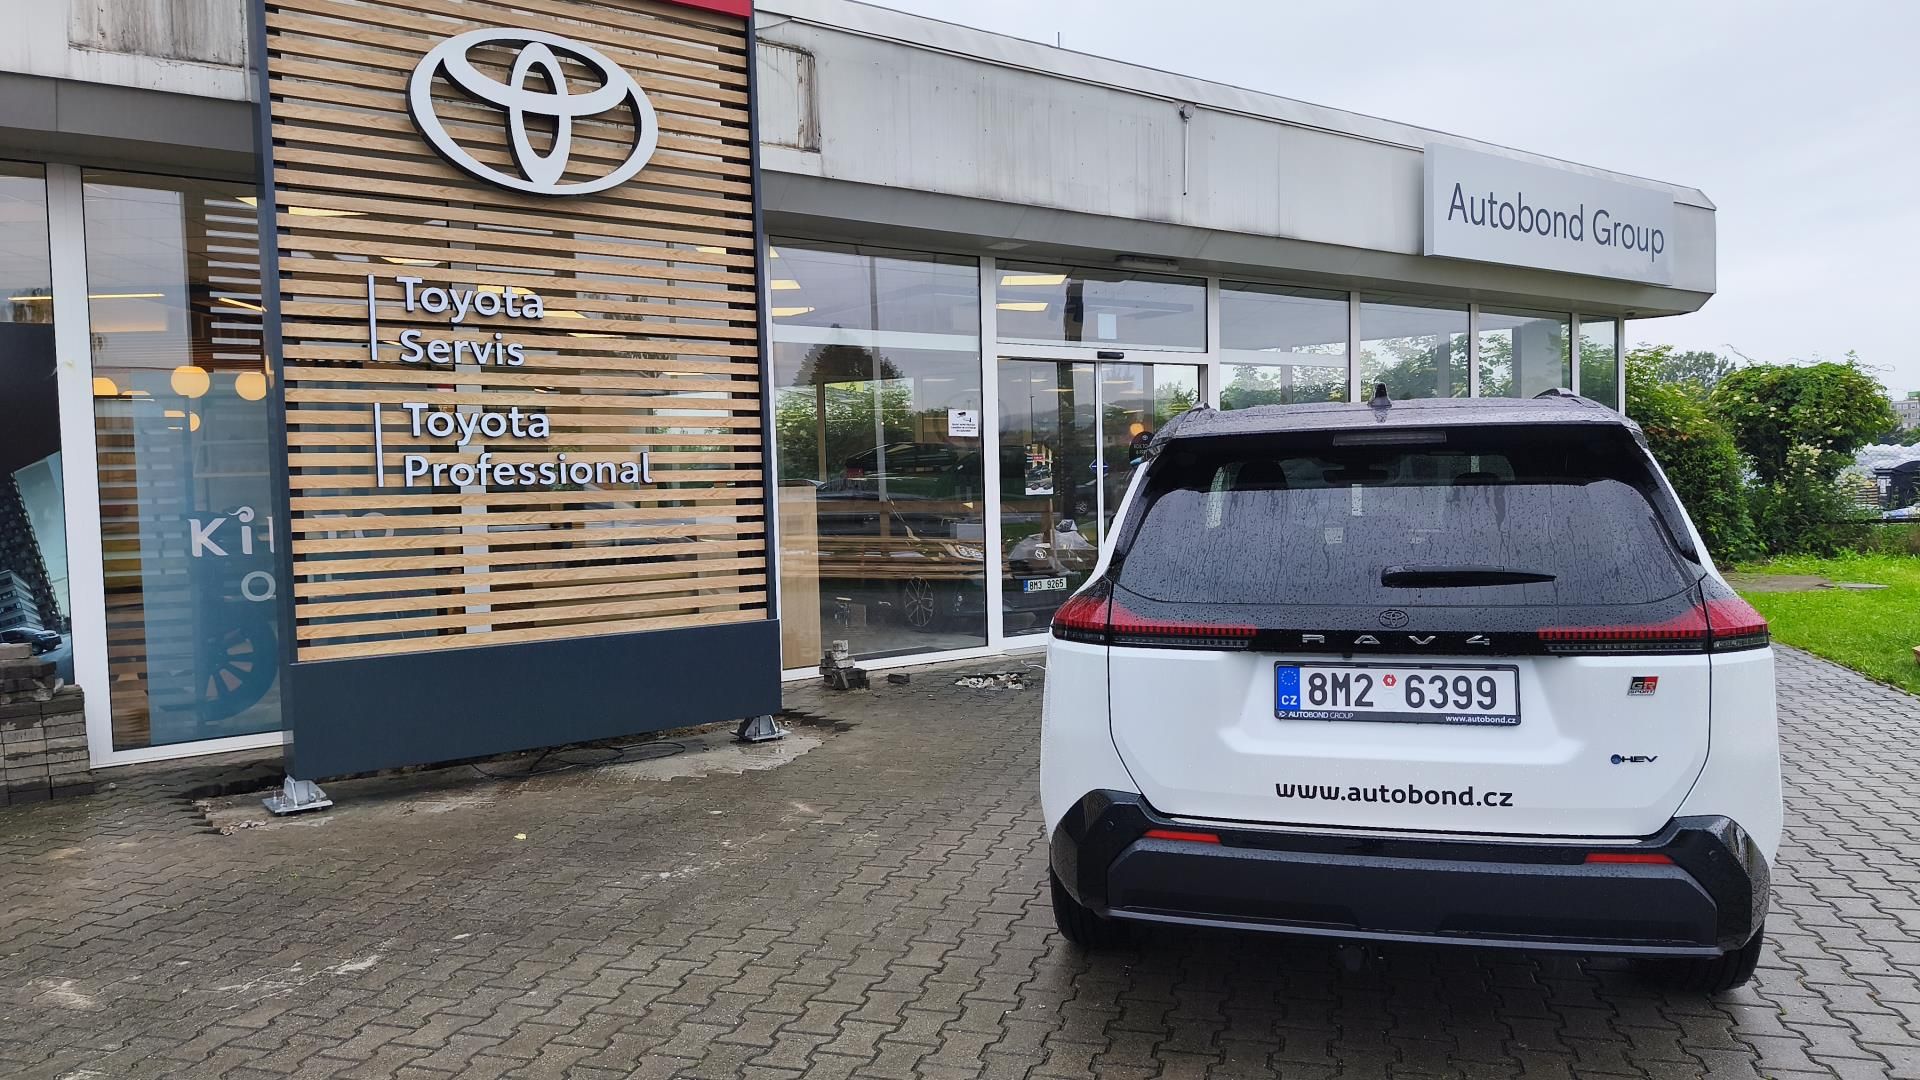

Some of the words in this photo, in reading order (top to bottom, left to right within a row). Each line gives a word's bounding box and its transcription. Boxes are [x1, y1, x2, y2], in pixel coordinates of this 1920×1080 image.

[1447, 182, 1584, 242] Autobond
[1592, 209, 1665, 262] Group
[396, 276, 545, 323] Toyota
[399, 329, 525, 366] Servis
[402, 402, 550, 446] Toyota
[403, 452, 653, 488] Professional
[1029, 580, 1042, 590] 8M3
[1047, 578, 1064, 588] 9265
[1302, 634, 1490, 646] RAV4
[1308, 672, 1374, 707] 8M2
[1405, 674, 1497, 711] 6399
[1631, 681, 1656, 690] GR
[1281, 694, 1298, 706] CZ
[1288, 711, 1329, 719] AUTOBOND
[1445, 714, 1517, 724] www.autobond.cz
[1275, 783, 1514, 807] www.autobond.cz
